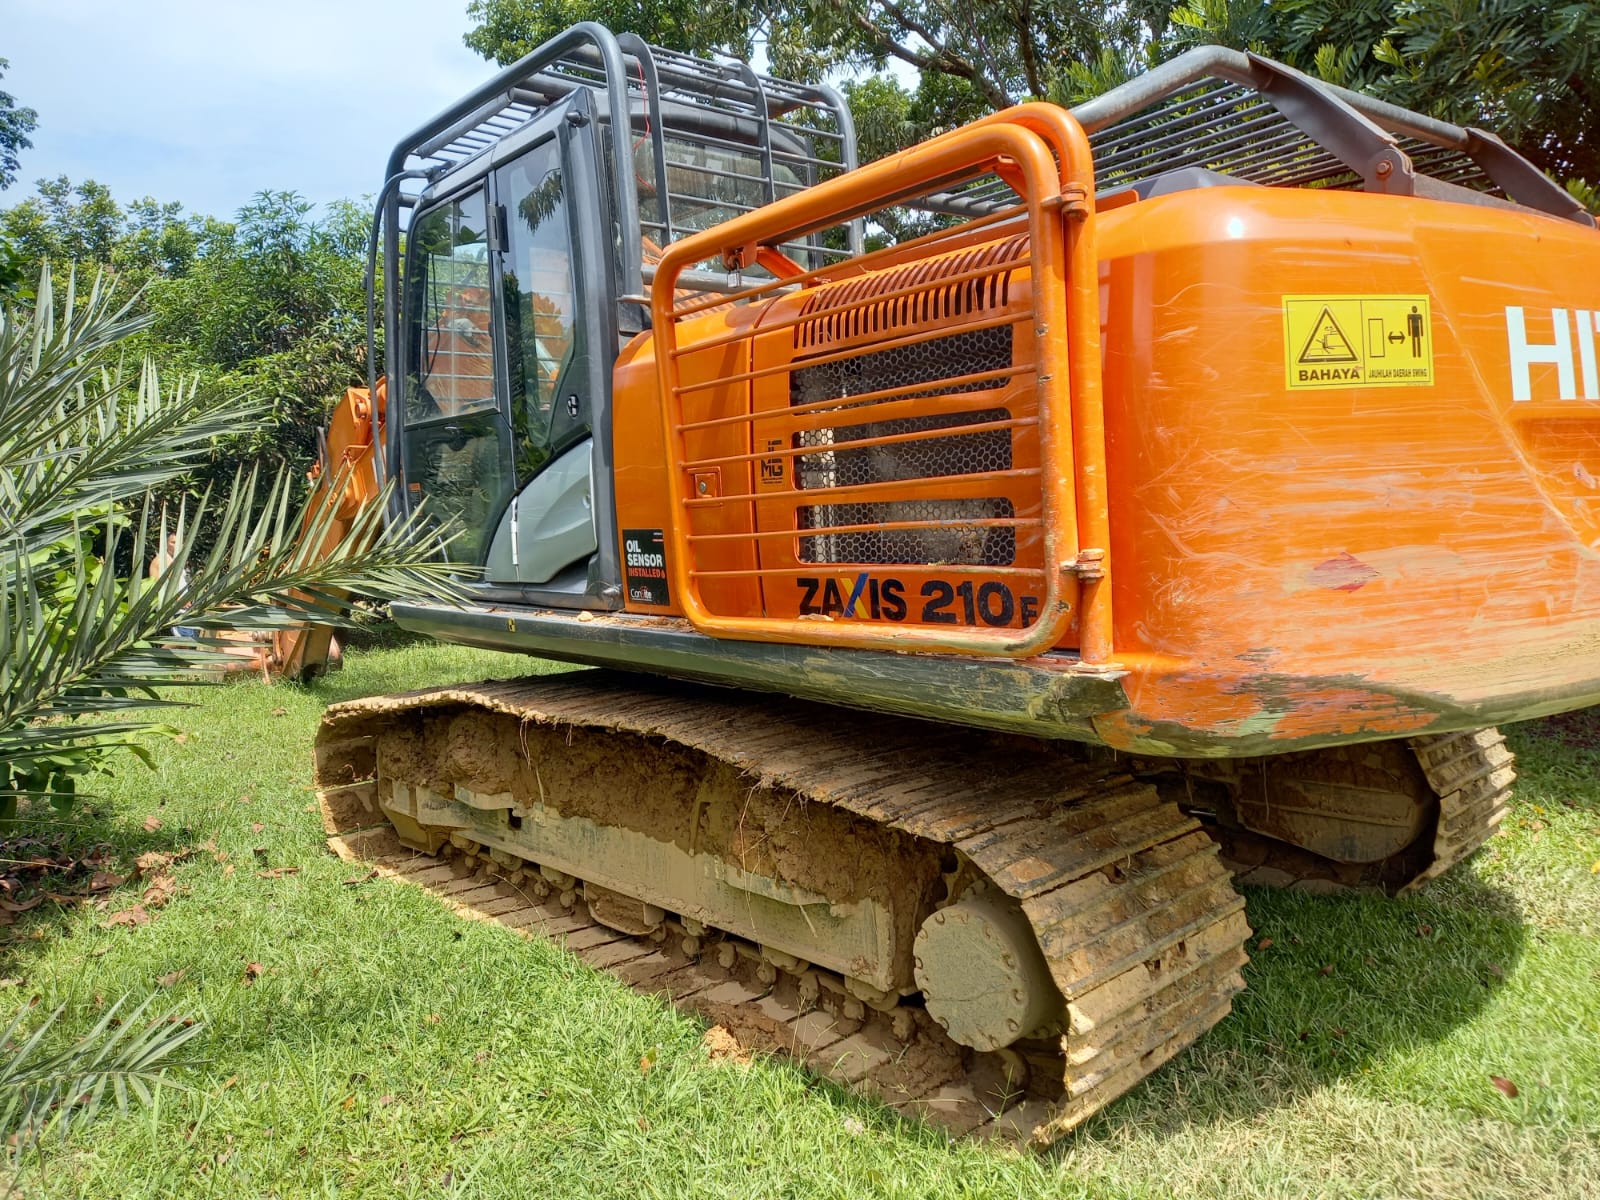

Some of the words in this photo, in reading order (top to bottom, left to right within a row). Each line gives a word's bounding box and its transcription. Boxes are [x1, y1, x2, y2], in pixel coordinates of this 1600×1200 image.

[1505, 306, 1600, 401] HI
[1298, 368, 1360, 381] BAHAYA
[626, 540, 641, 552] OIL
[627, 553, 663, 567] SENSOR
[628, 567, 660, 578] INSTALLED
[797, 572, 907, 621] ZAXIS
